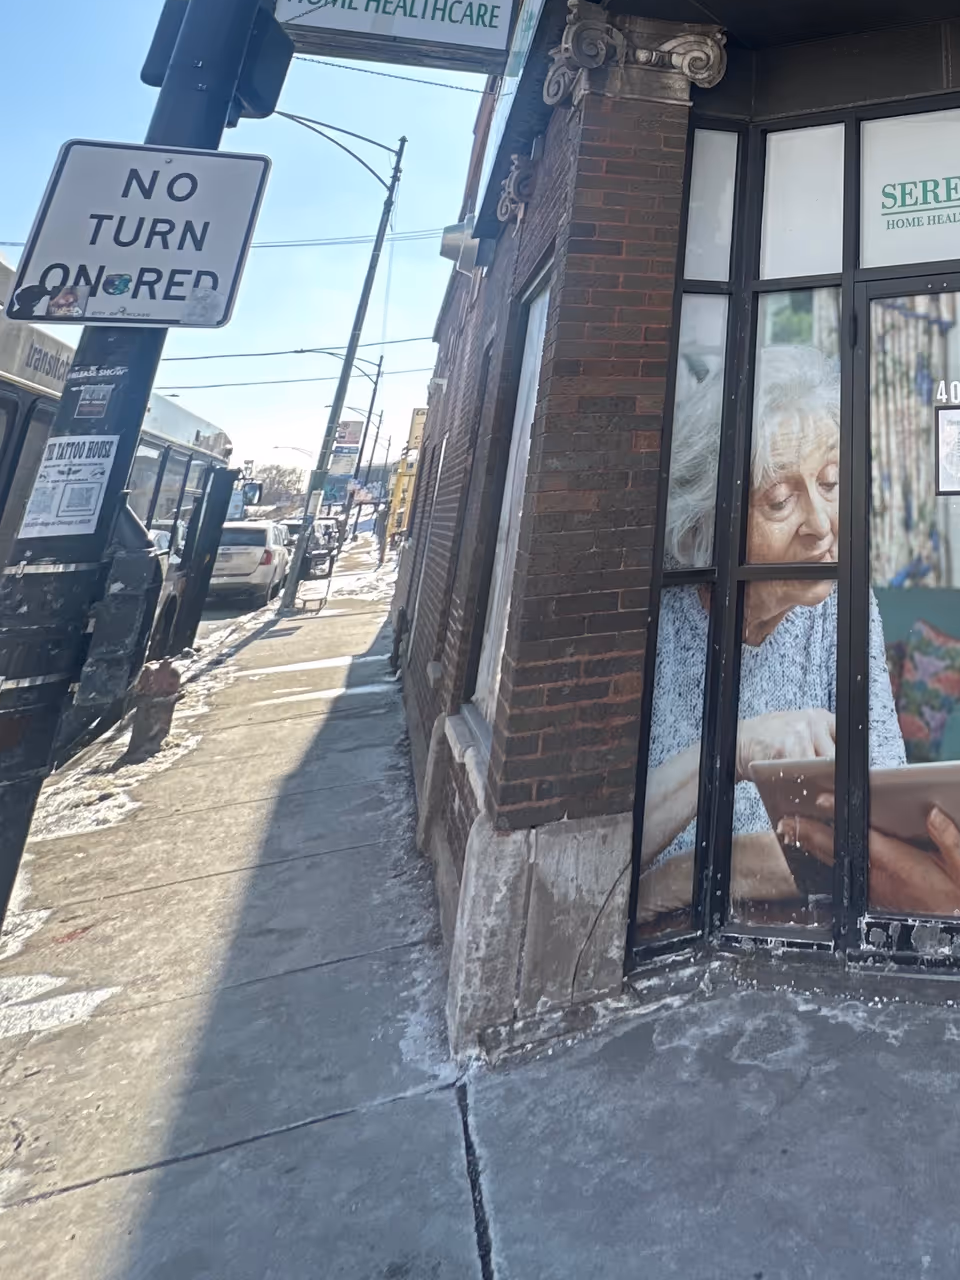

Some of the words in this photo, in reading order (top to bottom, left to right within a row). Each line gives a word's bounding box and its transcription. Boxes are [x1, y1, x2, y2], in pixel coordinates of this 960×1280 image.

[121, 168, 198, 202] NO
[89, 214, 210, 251] TURN
[886, 217, 924, 231] HOME
[39, 263, 106, 298] ON
[131, 267, 219, 303] RED
